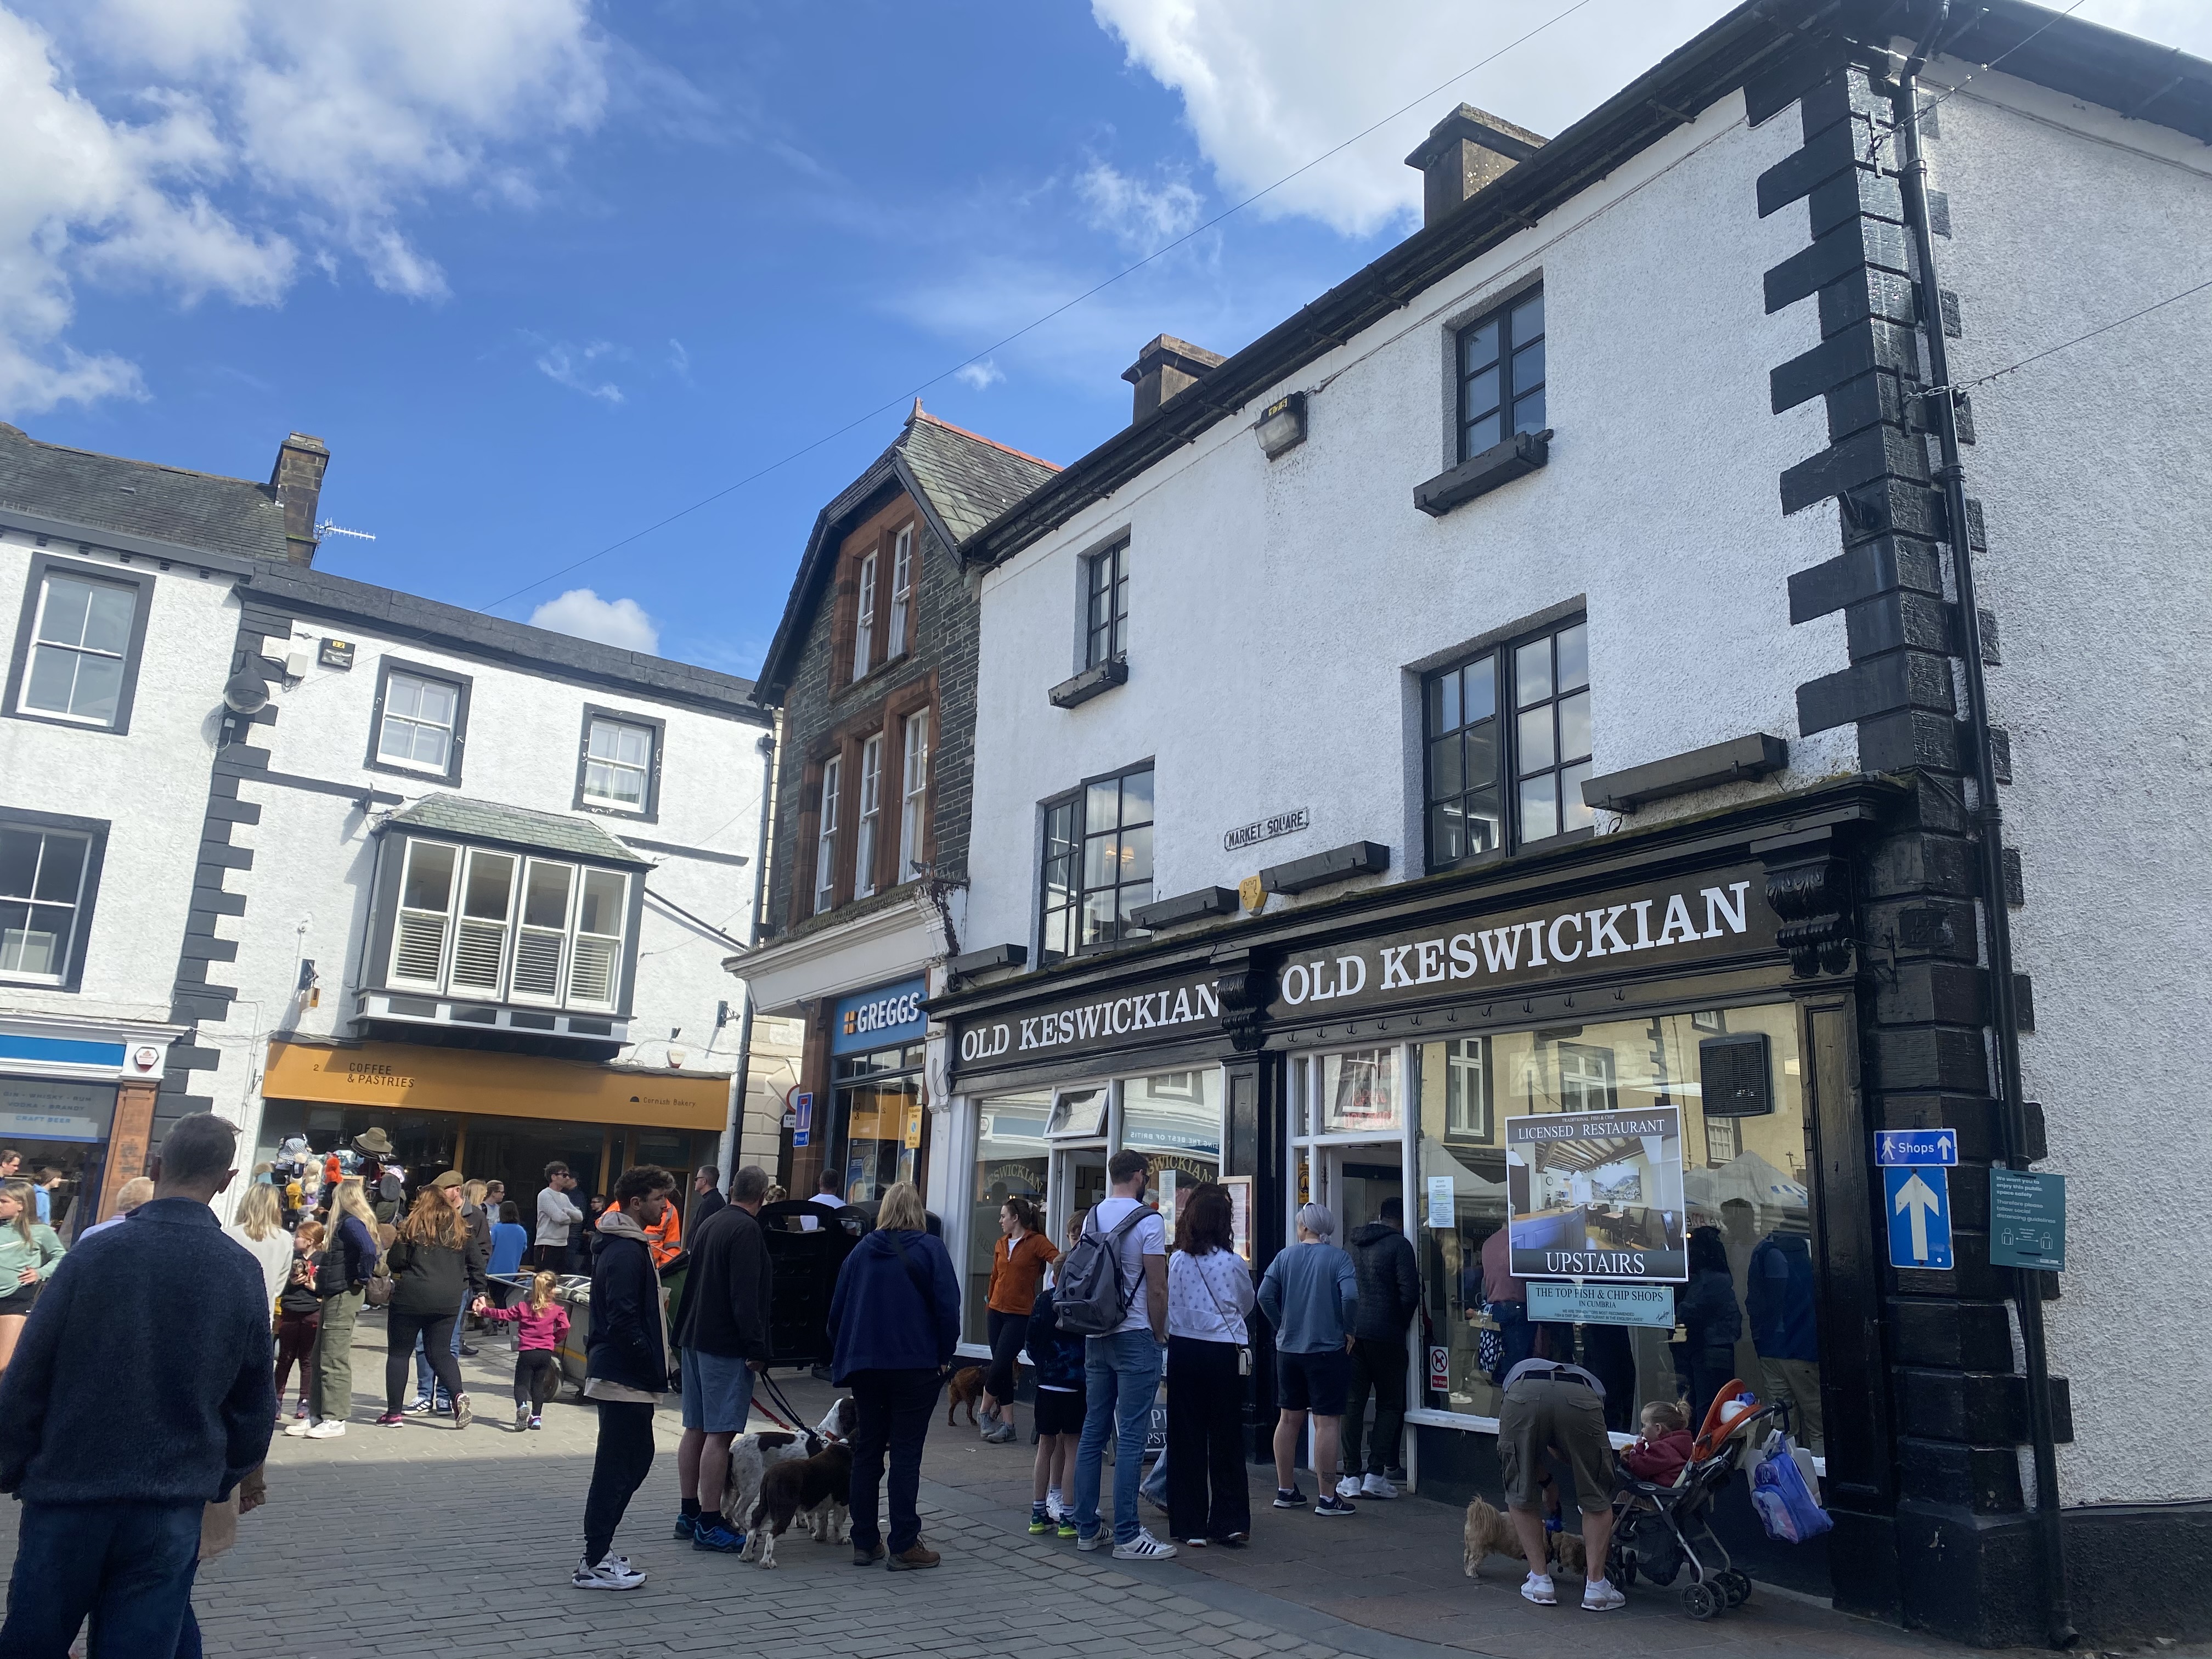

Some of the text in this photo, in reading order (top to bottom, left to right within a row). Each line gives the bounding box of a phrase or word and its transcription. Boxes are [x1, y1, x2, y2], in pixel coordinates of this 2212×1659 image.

[1229, 811, 1303, 847] MARKET SQUARE
[1282, 880, 1751, 1005] OLD KESWICKIAN
[857, 992, 921, 1032] GREGGS
[961, 981, 1220, 1061] OLD KESWICKIAN
[349, 1063, 392, 1075] COFFEE
[347, 1074, 415, 1087] & PASTRIES
[643, 1097, 696, 1108] Cornish Bakery
[1518, 1119, 1665, 1139] LICENSED RESTAURANT
[1898, 1142, 1934, 1155] Shops
[1996, 1213, 2026, 1222] distancing
[1545, 1252, 1645, 1274] UPSTAIRS
[1536, 1287, 1663, 1302] THE TOP FISH & CHIP SHOPS
